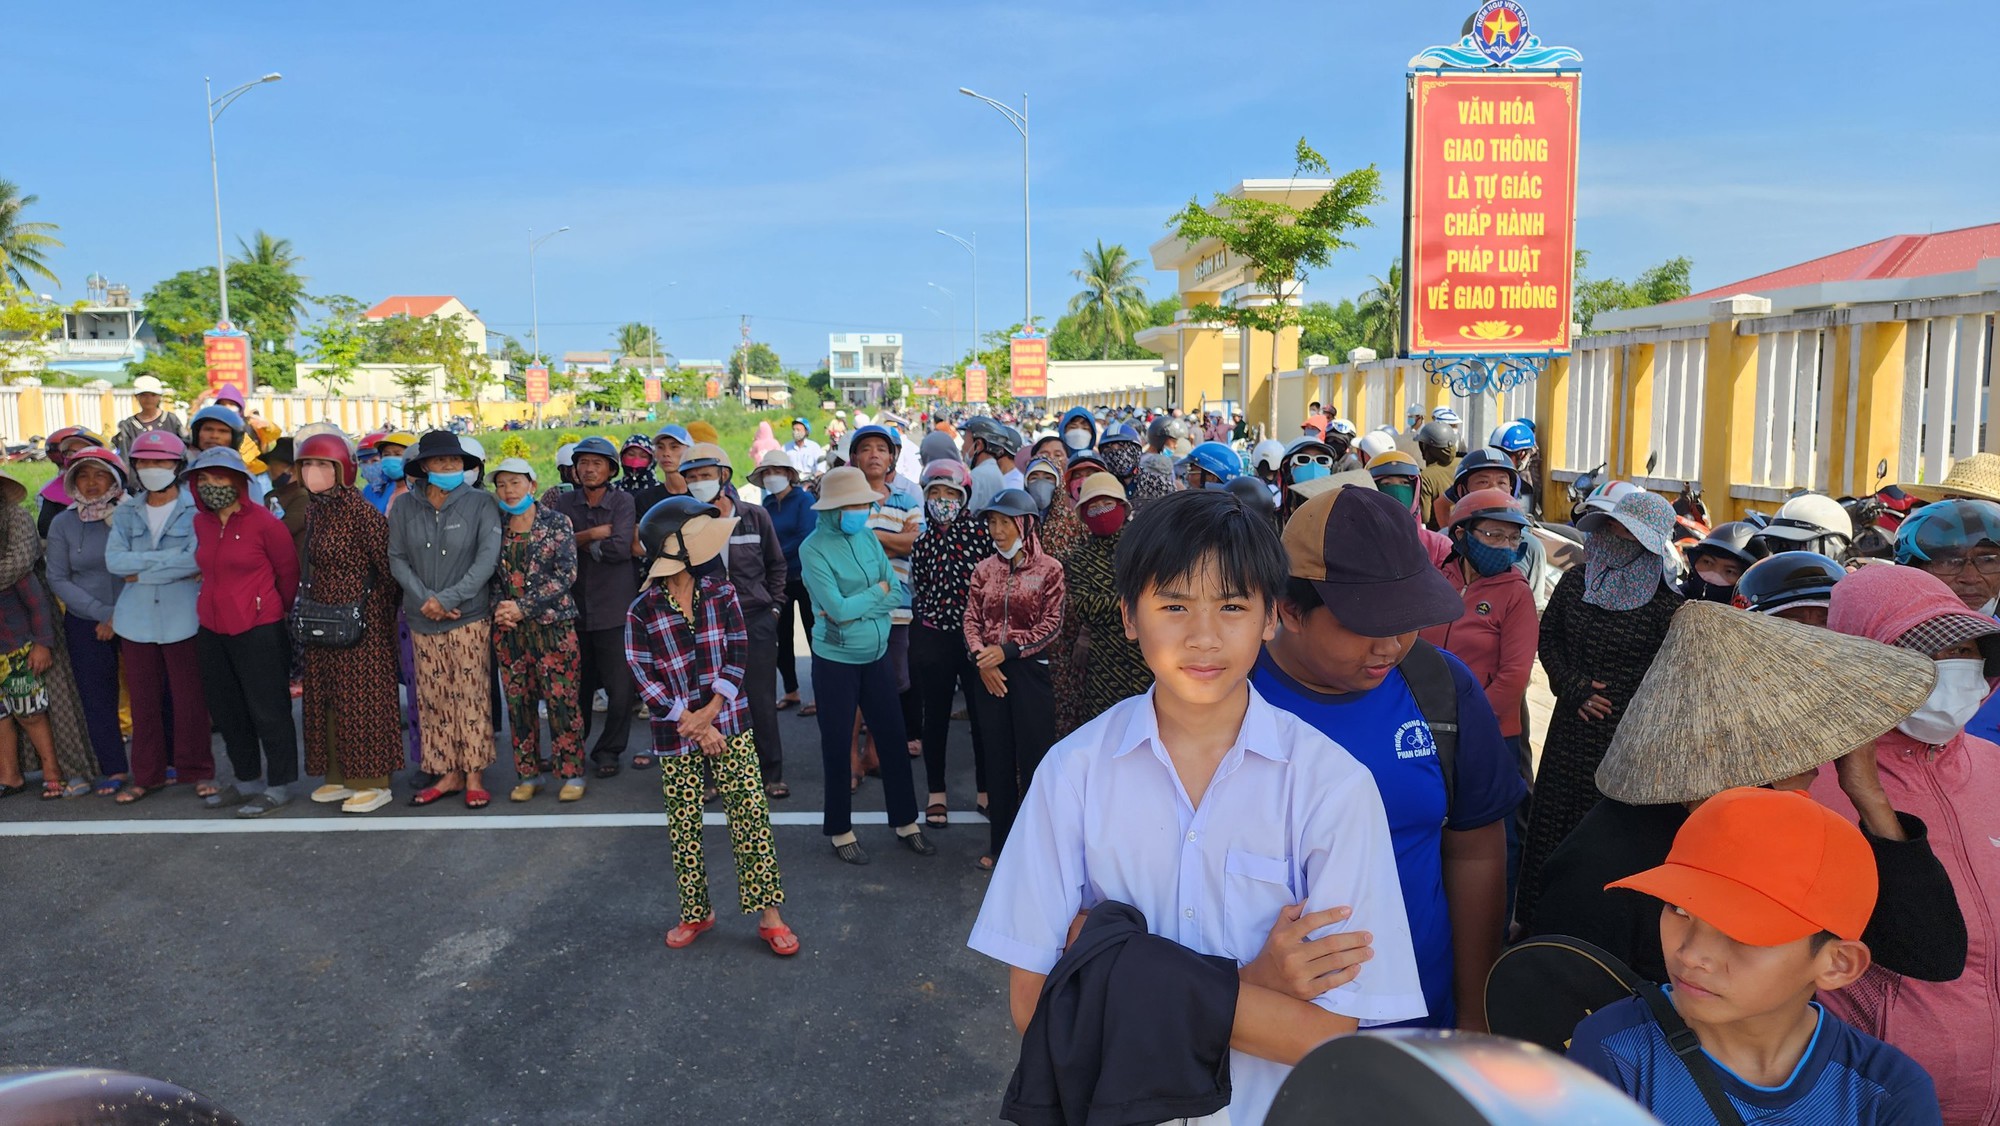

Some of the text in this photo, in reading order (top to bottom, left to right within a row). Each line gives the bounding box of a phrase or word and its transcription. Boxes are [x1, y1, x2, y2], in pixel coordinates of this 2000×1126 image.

[1504, 1, 1519, 12] VIỆT
[1517, 11, 1527, 27] NAM
[1458, 96, 1535, 124] VĂN HÓA
[1443, 133, 1548, 162] GIAO THÔNG
[1448, 170, 1542, 204] LÀ TỰ GIÁC
[1444, 204, 1544, 236] CHẤP HÀNH
[1446, 244, 1541, 277] PHÁP LUẬT
[1427, 279, 1557, 310] VỀ GIAO THÔNG
[11, 676, 27, 686] THE
[1401, 720, 1421, 730] TRUNG
[1397, 750, 1414, 759] PHAN
[1414, 748, 1431, 757] CHÂU
